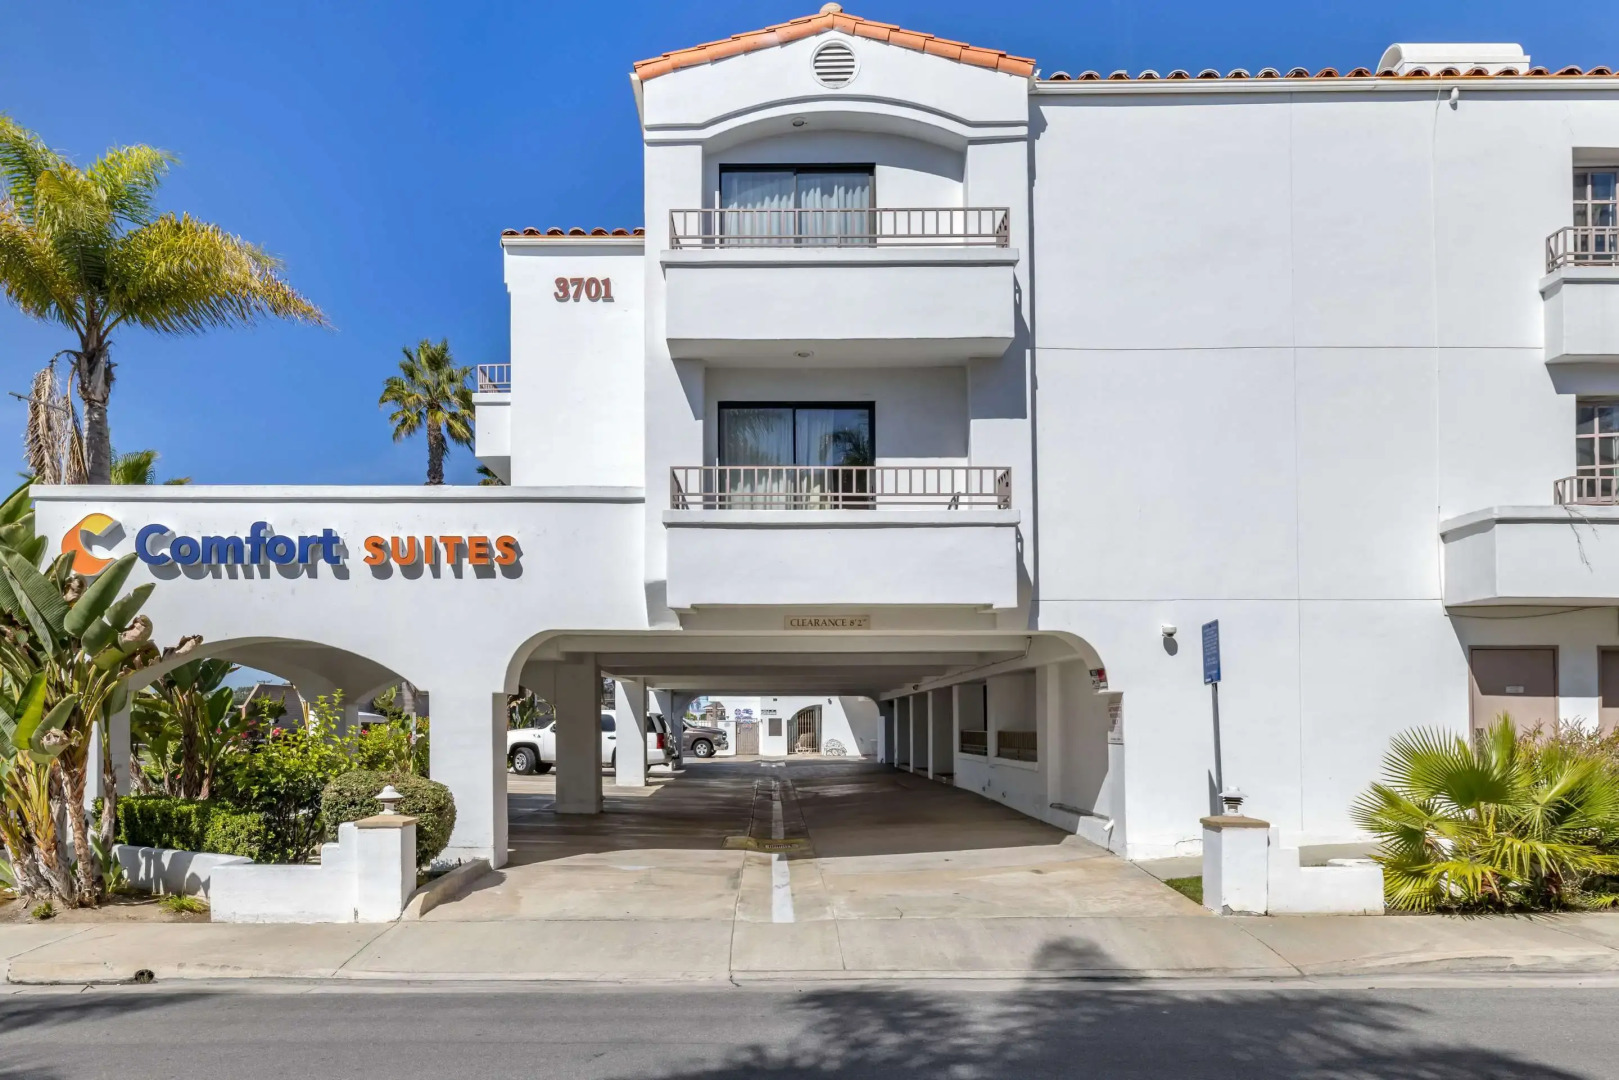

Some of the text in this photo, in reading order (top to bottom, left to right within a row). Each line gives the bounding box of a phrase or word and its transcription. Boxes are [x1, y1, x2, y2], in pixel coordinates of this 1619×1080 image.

[554, 277, 614, 302] 3701
[135, 521, 518, 566] Comfort SUITES
[790, 618, 846, 626] CLEARANCE
